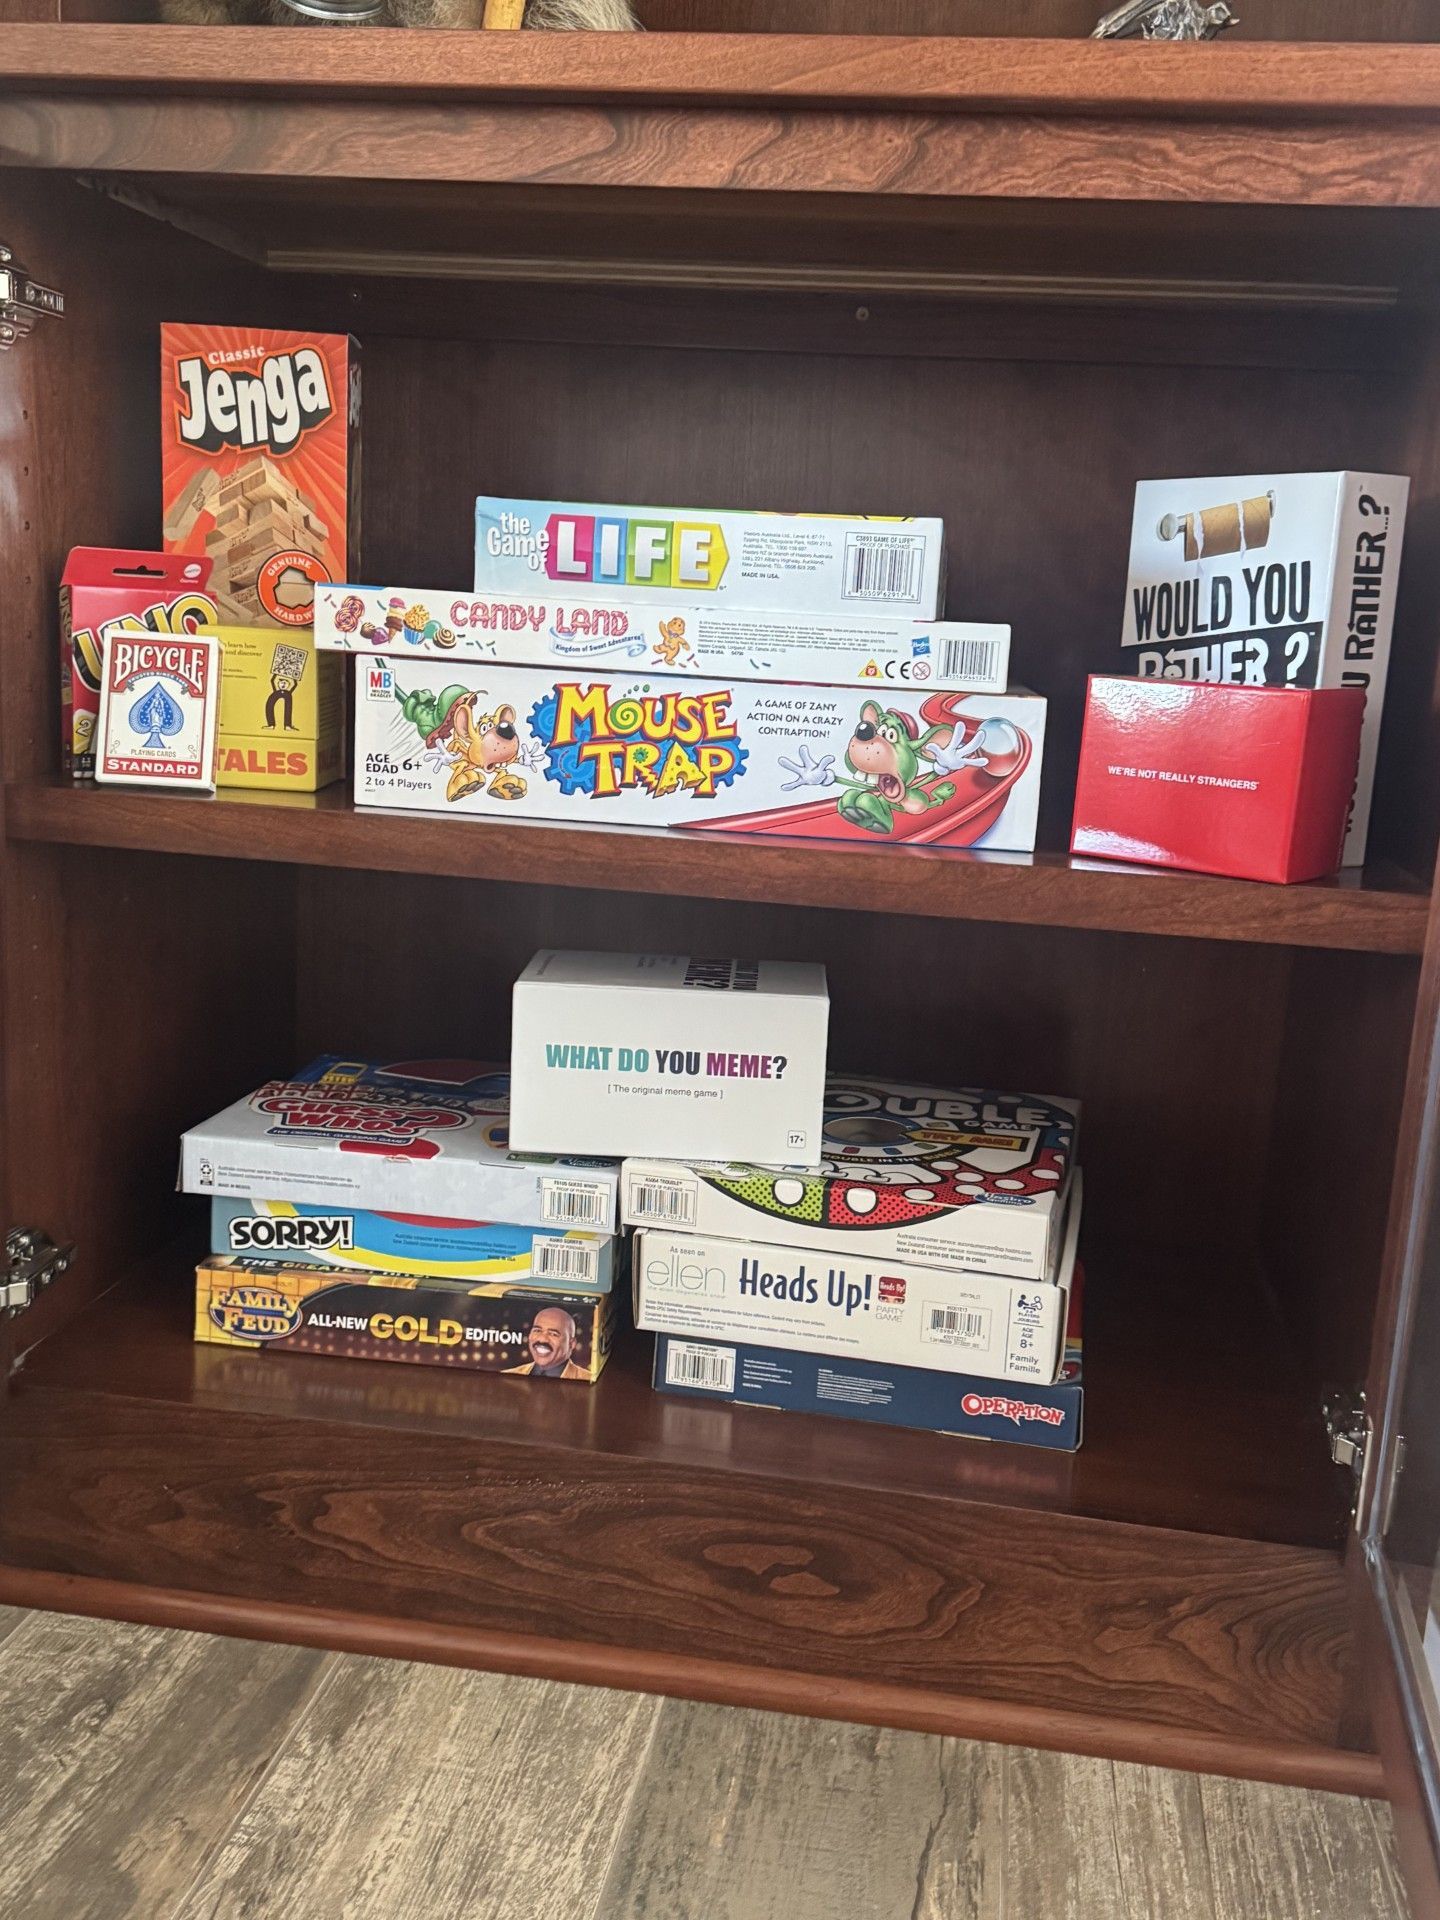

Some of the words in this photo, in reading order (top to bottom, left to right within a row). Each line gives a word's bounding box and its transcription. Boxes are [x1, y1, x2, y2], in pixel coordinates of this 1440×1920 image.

[208, 345, 265, 364] Classic
[180, 349, 331, 445] Jenga
[501, 512, 531, 535] the
[487, 527, 550, 557] Game
[556, 520, 711, 583] LIFE
[267, 555, 313, 578] GENUINE
[528, 551, 548, 574] of
[1133, 575, 1233, 641] WOULD
[1242, 560, 1311, 626] YOU
[449, 600, 546, 632] CANDY
[556, 607, 628, 637] LAND
[555, 644, 581, 653] Kingdom
[582, 644, 588, 652] of
[589, 642, 607, 651] Sweet
[608, 635, 641, 646] Adventures
[113, 643, 204, 694] BICYCLE
[370, 671, 392, 688] MB
[755, 699, 762, 707] A
[765, 700, 792, 709] GAME
[795, 701, 807, 709] OF
[809, 702, 837, 711] ZANY
[550, 683, 738, 746] MOUSE
[747, 712, 782, 721] ACTION
[785, 714, 800, 723] ON
[802, 716, 810, 724] A
[812, 716, 843, 725] CRAZY
[758, 726, 830, 738] CONTRAPTION!
[131, 749, 156, 758] PLAYING
[157, 750, 177, 759] CARDS
[366, 752, 390, 764] AGE
[107, 758, 199, 775] STANDARD
[366, 763, 399, 774] EDAD
[402, 758, 422, 771] 6+
[578, 740, 736, 799] TRAP
[365, 776, 372, 786] 2
[375, 778, 386, 786] to
[388, 778, 395, 787] 4
[397, 778, 432, 791] Players
[1108, 765, 1137, 777] WE'RE
[1138, 768, 1158, 779] NOT
[1159, 771, 1196, 783] REALLY
[1197, 775, 1258, 791] STRANGERS
[546, 1044, 613, 1071] WHAT
[617, 1047, 650, 1073] DO
[655, 1050, 701, 1076] YOU
[706, 1052, 788, 1080] MEME?
[613, 1084, 630, 1095] The
[632, 1085, 663, 1096] original
[664, 1088, 692, 1097] meme
[693, 1089, 718, 1099] game
[824, 1088, 1050, 1128] OUBLE
[963, 1119, 1033, 1132] GAME
[789, 1134, 804, 1145] 17+
[877, 1156, 891, 1164] IN
[894, 1154, 921, 1163] THE
[230, 1217, 353, 1251] SORRY!
[670, 1246, 678, 1254] As
[680, 1248, 695, 1256] seen
[242, 1257, 278, 1268] THE
[646, 1254, 726, 1293] ellen
[739, 1258, 819, 1304] Heads
[827, 1268, 873, 1316] Up!
[879, 1281, 896, 1291] Heads
[210, 1285, 304, 1317] FAMILY
[875, 1305, 904, 1316] PARTY
[875, 1313, 904, 1323] GAME
[222, 1308, 291, 1335] FEUD
[308, 1312, 369, 1331] ALL-NEW
[370, 1312, 464, 1346] GOLD
[465, 1327, 523, 1345] EDITION
[1019, 1339, 1034, 1349] 8+
[1009, 1362, 1041, 1374] Famille
[1010, 1353, 1039, 1365] Family
[962, 1393, 1064, 1426] OPERATION
